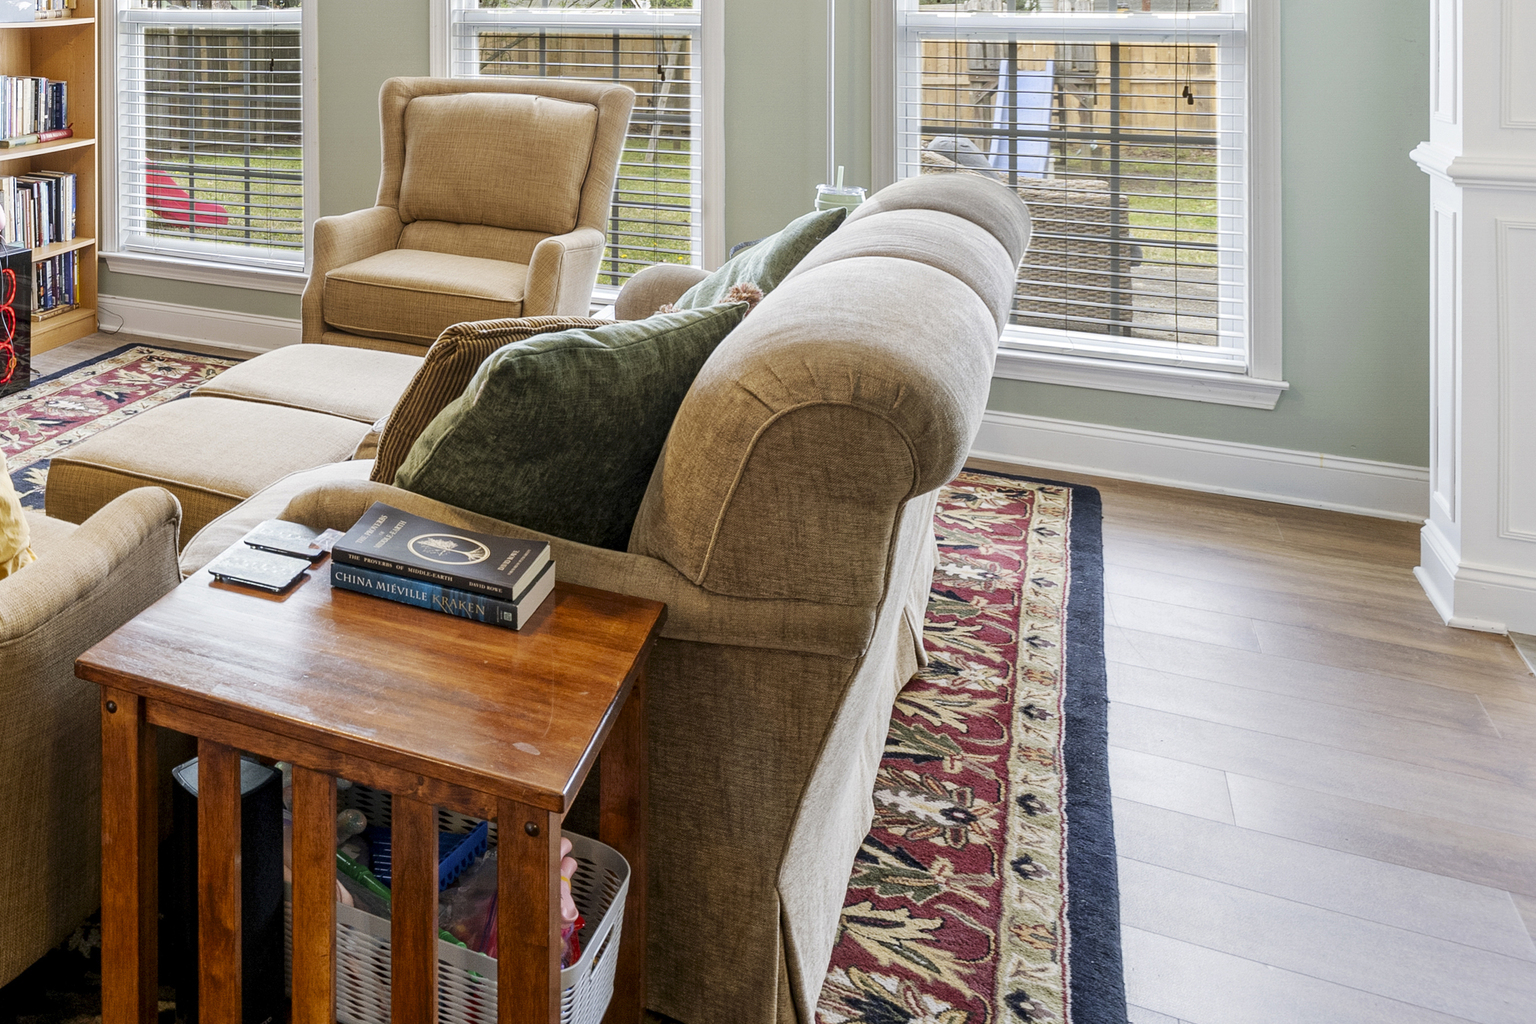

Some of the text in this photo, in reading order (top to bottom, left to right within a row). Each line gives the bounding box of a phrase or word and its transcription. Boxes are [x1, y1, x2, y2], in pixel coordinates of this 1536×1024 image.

[335, 571, 485, 619] CHINA MIÉVILLE KRAKEN
[364, 557, 393, 568] PROVERBS
[408, 567, 453, 582] MIDDLE-EARTH
[469, 581, 485, 589] DAVID
[486, 585, 502, 593] ROWE
